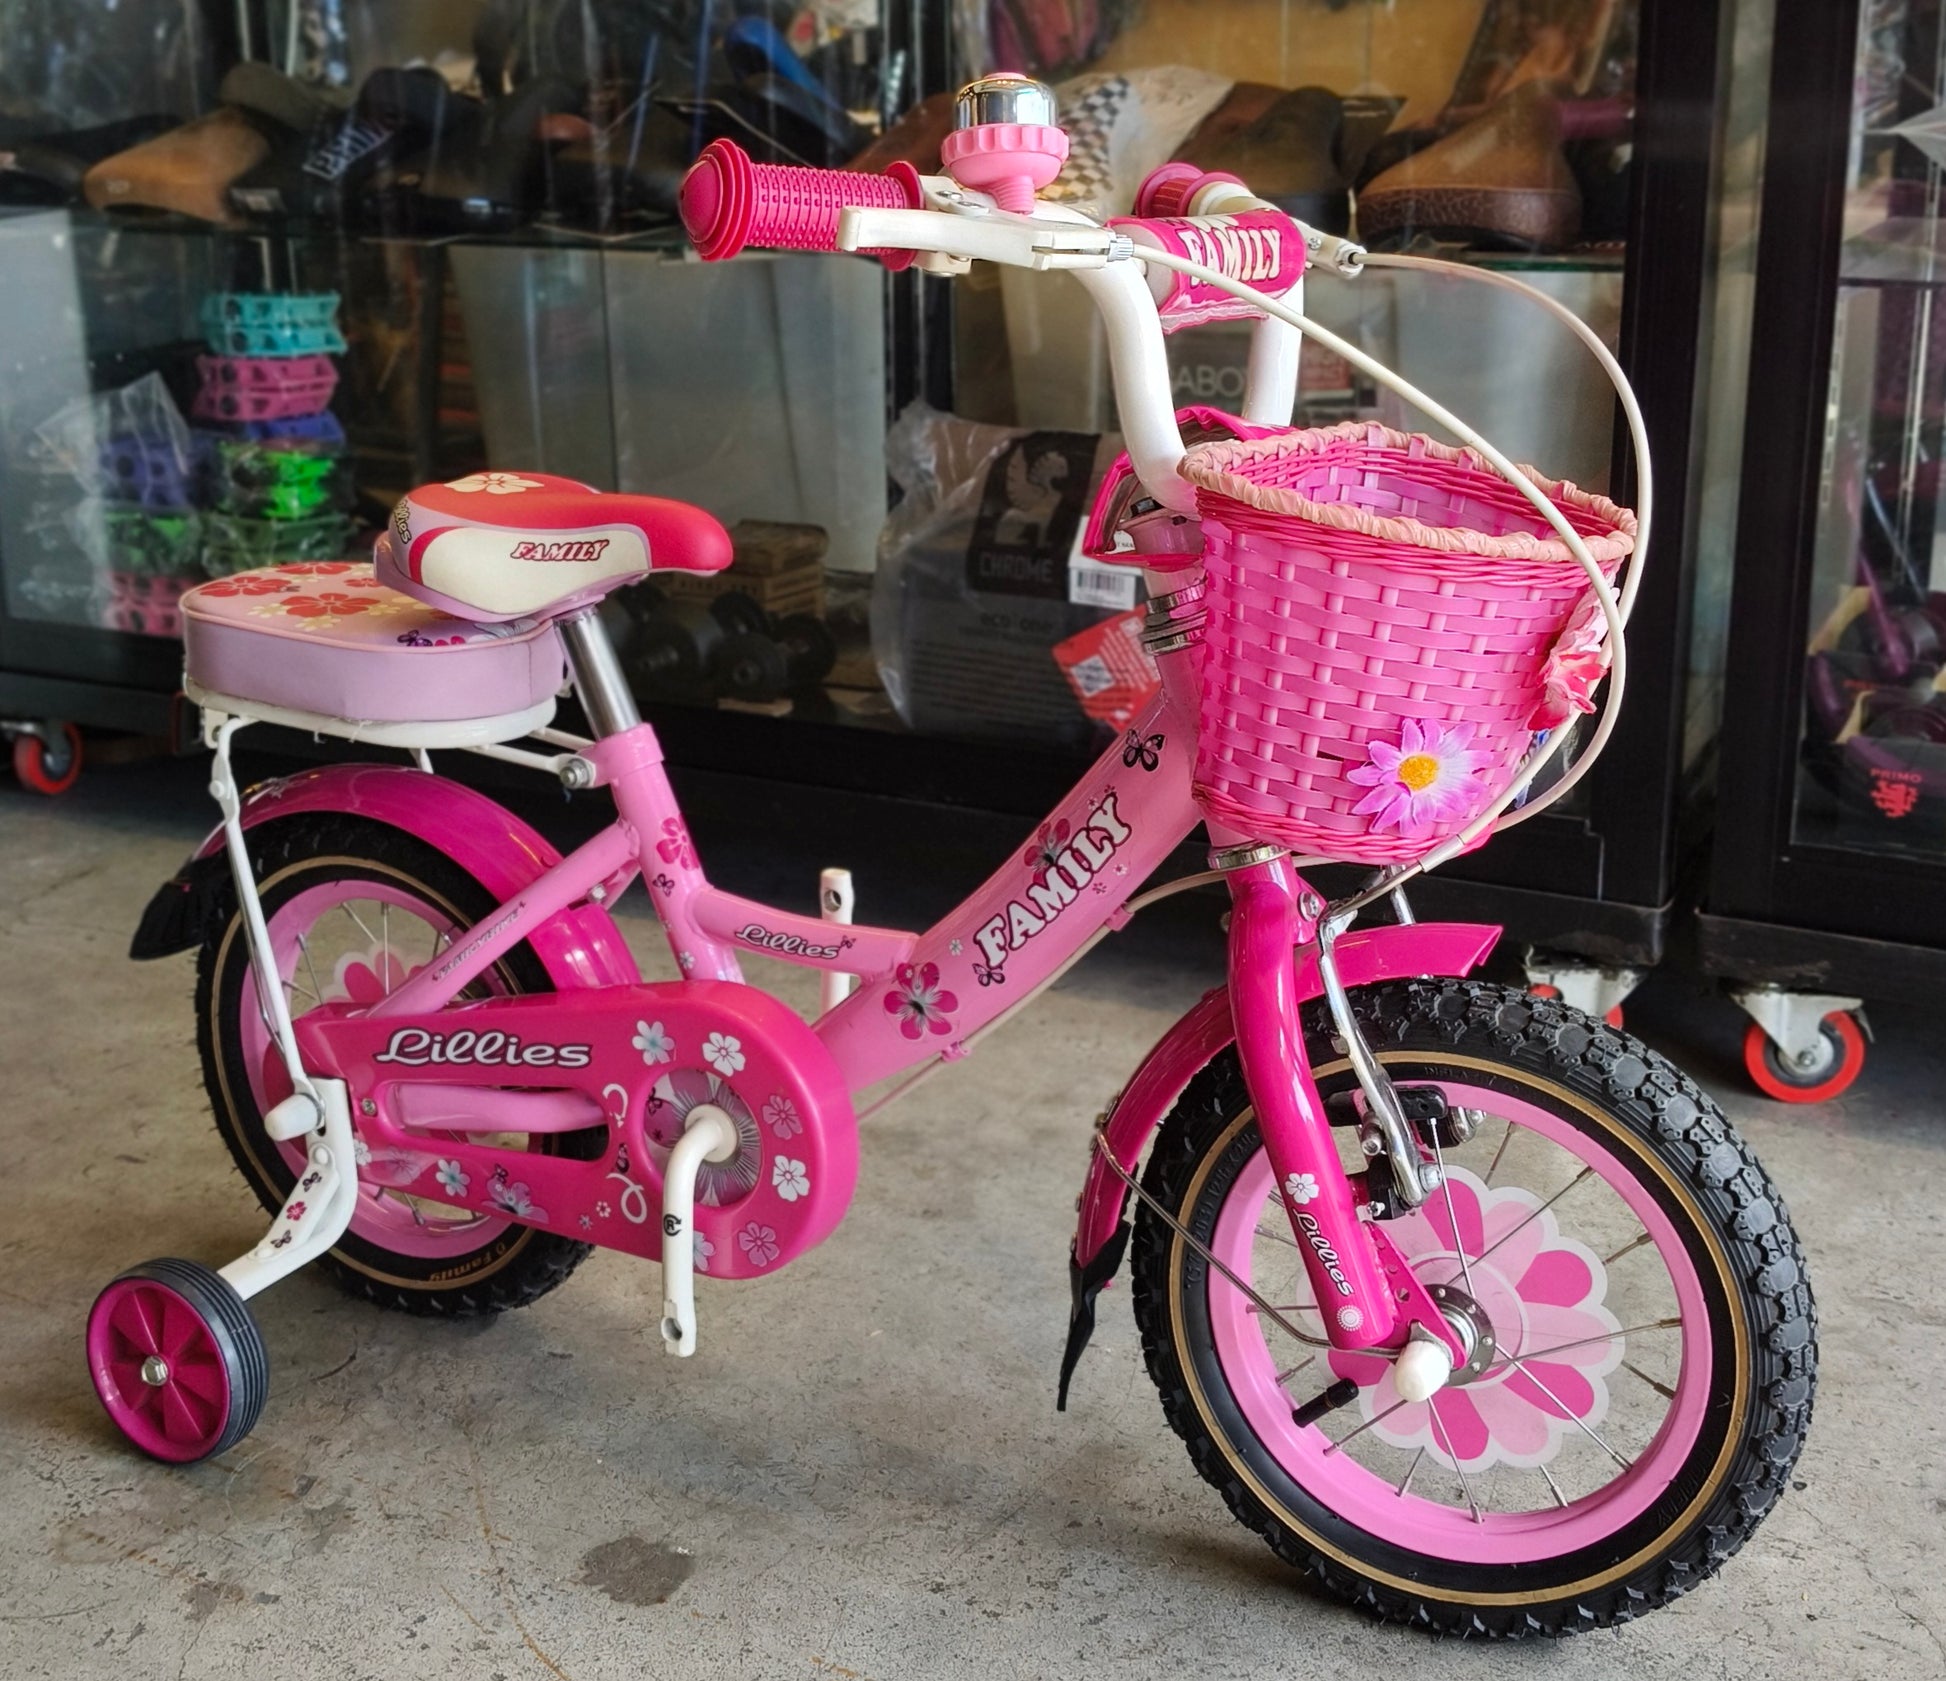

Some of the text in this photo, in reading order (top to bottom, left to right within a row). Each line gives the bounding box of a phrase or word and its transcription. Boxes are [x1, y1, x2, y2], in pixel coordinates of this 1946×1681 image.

[1176, 226, 1281, 289] FAMILY
[510, 539, 609, 561] FAMILY
[979, 551, 1055, 583] CHROME
[1870, 767, 1922, 784] PRIMO
[973, 792, 1132, 970] FAMILY
[735, 923, 842, 959] Lillies
[373, 1026, 593, 1068] Lillies
[428, 1252, 493, 1281] Family
[1291, 1206, 1355, 1297] Lillies
